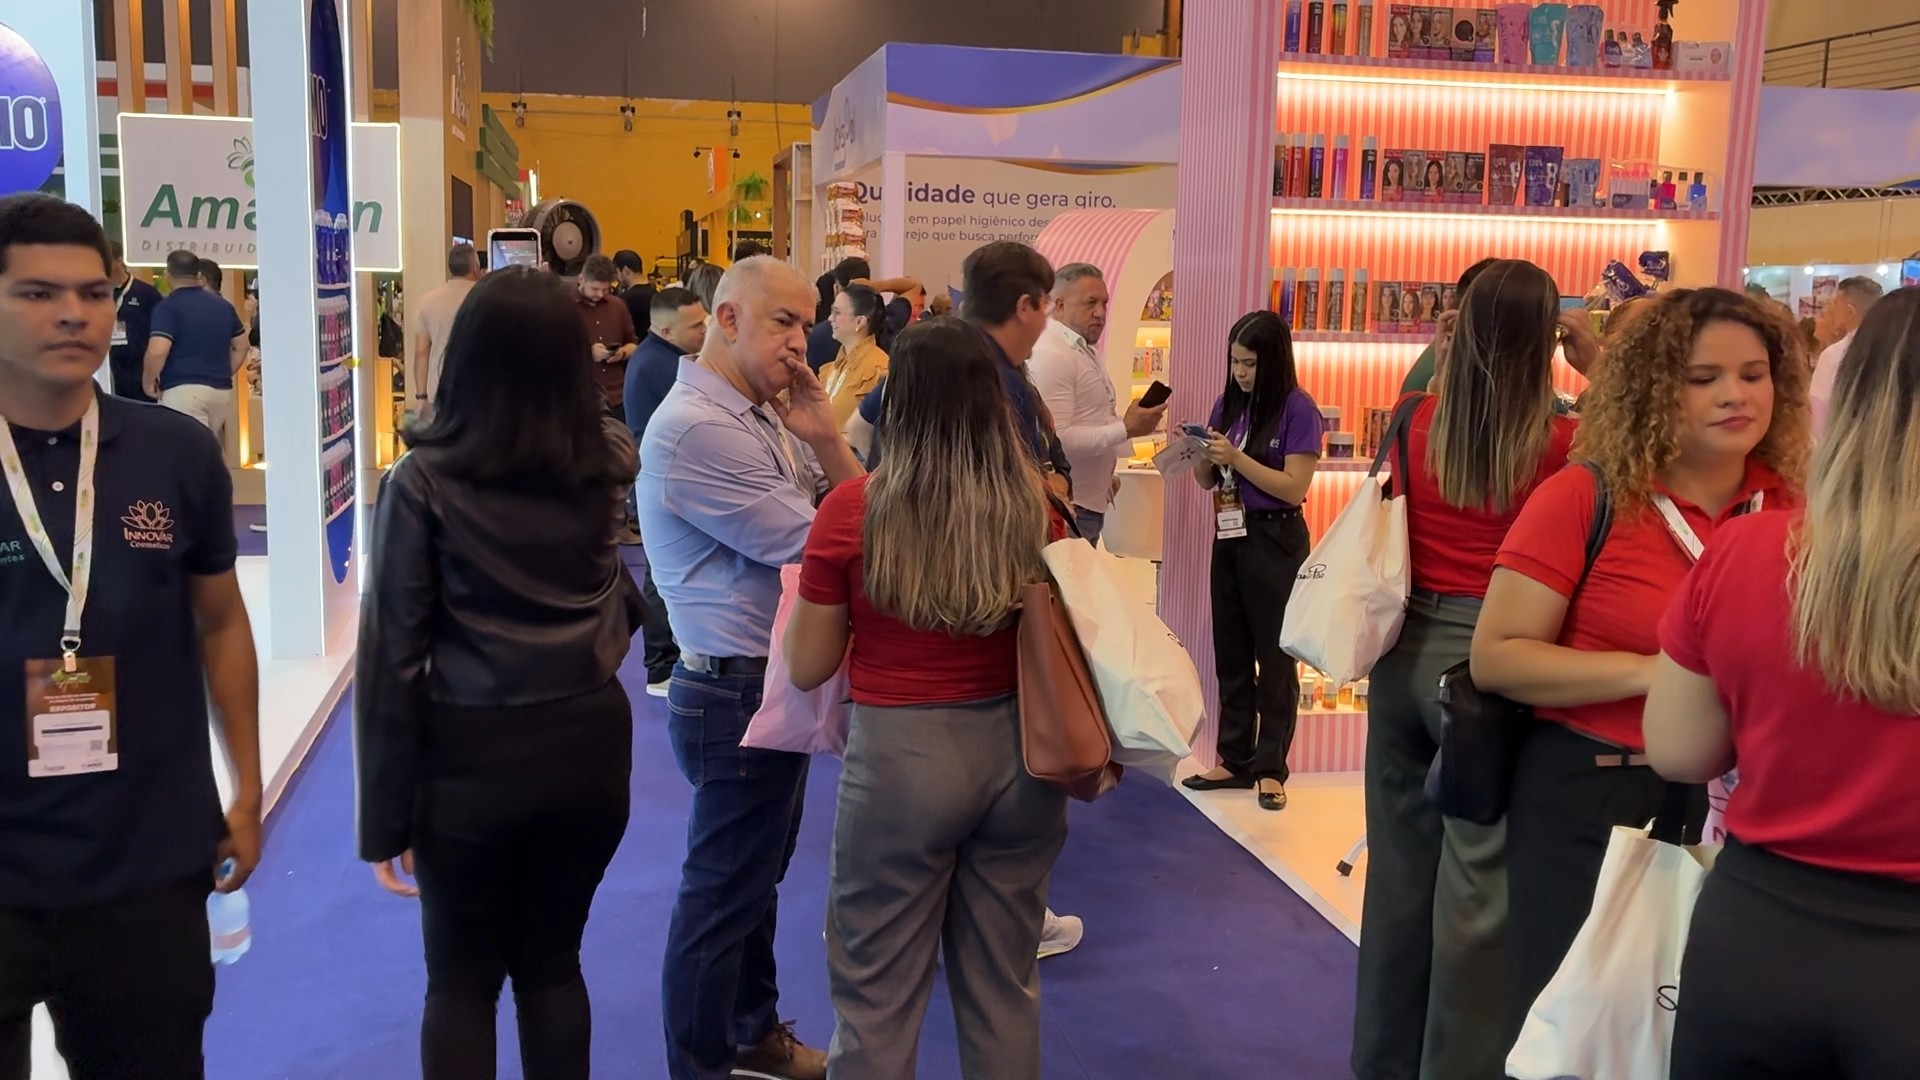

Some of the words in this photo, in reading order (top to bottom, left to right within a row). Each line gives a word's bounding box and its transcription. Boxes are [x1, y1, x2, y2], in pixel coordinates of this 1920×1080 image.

[855, 181, 976, 204] Quidade
[983, 191, 1021, 209] que
[1026, 192, 1069, 210] gera
[1074, 191, 1117, 210] giro.
[908, 215, 929, 224] em
[932, 214, 966, 227] papel
[969, 215, 1026, 230] higiênico
[904, 230, 929, 241] rejo
[931, 232, 956, 242] que
[959, 230, 995, 241] busca
[123, 527, 174, 543] INNOVAR
[49, 703, 97, 713] EXPOSITOR
